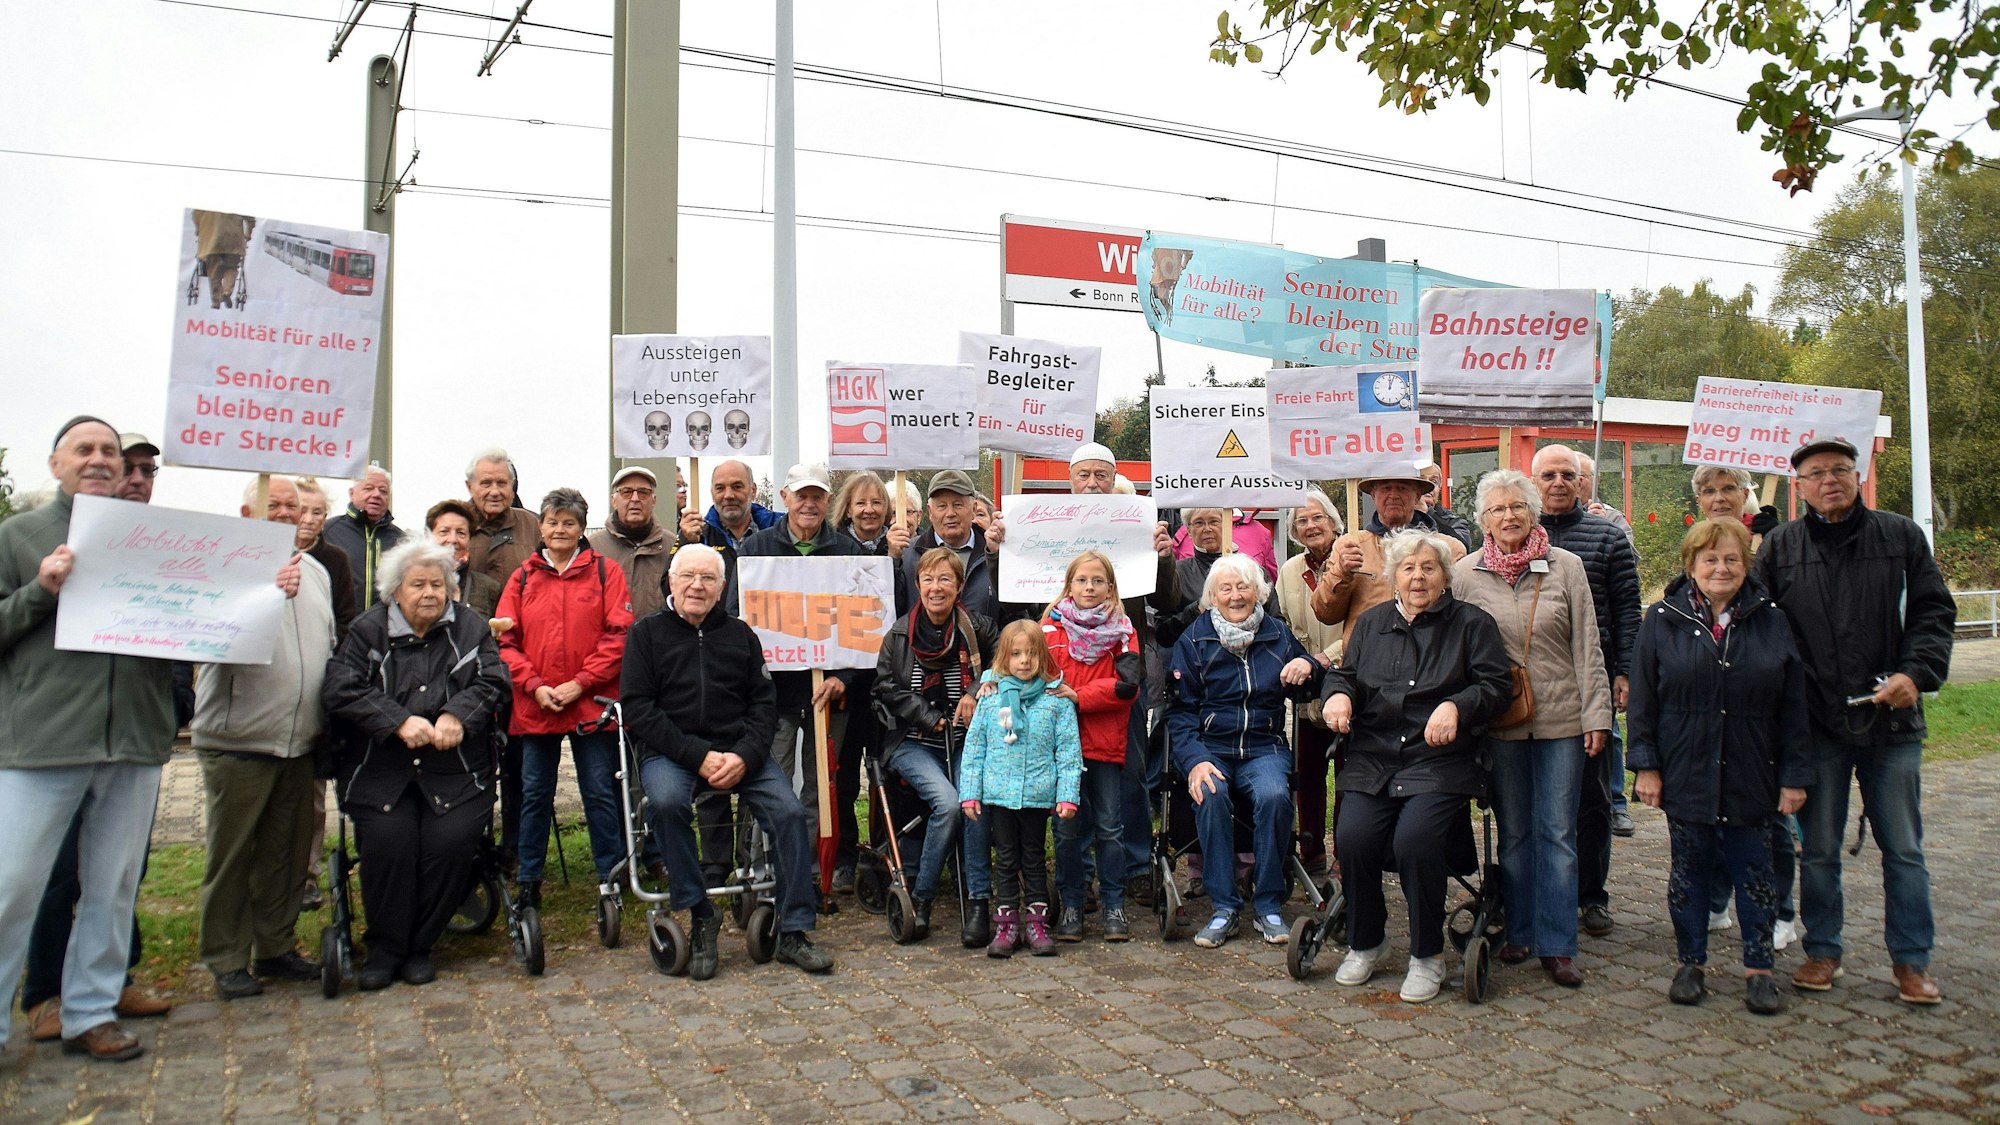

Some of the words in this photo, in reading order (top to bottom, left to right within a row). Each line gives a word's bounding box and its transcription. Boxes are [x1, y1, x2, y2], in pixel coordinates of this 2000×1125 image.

[1097, 241, 1137, 275] Wi
[1093, 289, 1124, 303] Bonn
[1131, 292, 1139, 304] R
[1184, 273, 1266, 303] Mobilität
[1282, 271, 1399, 305] Senioren
[1180, 293, 1208, 315] für
[1213, 301, 1262, 324] alle?
[1287, 302, 1380, 334] bleiben
[186, 319, 277, 343] Mobiltät
[283, 327, 313, 347] für
[318, 333, 356, 352] alle
[1429, 310, 1590, 341] Bahnsteige
[641, 344, 742, 363] Aussteigen
[988, 345, 1078, 370] Fahrgast-
[1319, 332, 1362, 356] der
[1369, 338, 1418, 361] Stre
[1461, 345, 1528, 371] hoch
[1535, 347, 1556, 371] !!
[215, 365, 331, 395] Senioren
[670, 368, 720, 383] unter
[836, 375, 879, 401] HGK
[986, 370, 1076, 392] Begleiter
[633, 388, 757, 408] Lebensgefahr
[888, 387, 925, 402] wer
[1022, 398, 1047, 416] für
[1275, 393, 1312, 405] Freie
[1315, 390, 1355, 403] Fahrt
[1699, 397, 1795, 416] Menschenrecht
[1701, 383, 1800, 402] Barrierefreiheit
[1802, 393, 1819, 404] ist
[1822, 394, 1842, 406] ein
[196, 394, 293, 424] bleiben
[301, 407, 345, 428] auf
[890, 411, 960, 428] mauert
[1155, 402, 1225, 419] Sicherer
[1231, 403, 1267, 417] Eins
[180, 423, 225, 446] der
[239, 430, 338, 457] Strecke
[978, 415, 1003, 430] Ein
[1016, 419, 1085, 442] Ausstieg
[1288, 428, 1337, 457] für
[1344, 425, 1404, 454] alle
[1692, 421, 1741, 443] weg
[1749, 425, 1791, 445] mit
[1687, 442, 1792, 472] Barriere
[1155, 474, 1225, 489] Sicherer
[763, 645, 806, 663] etzt
